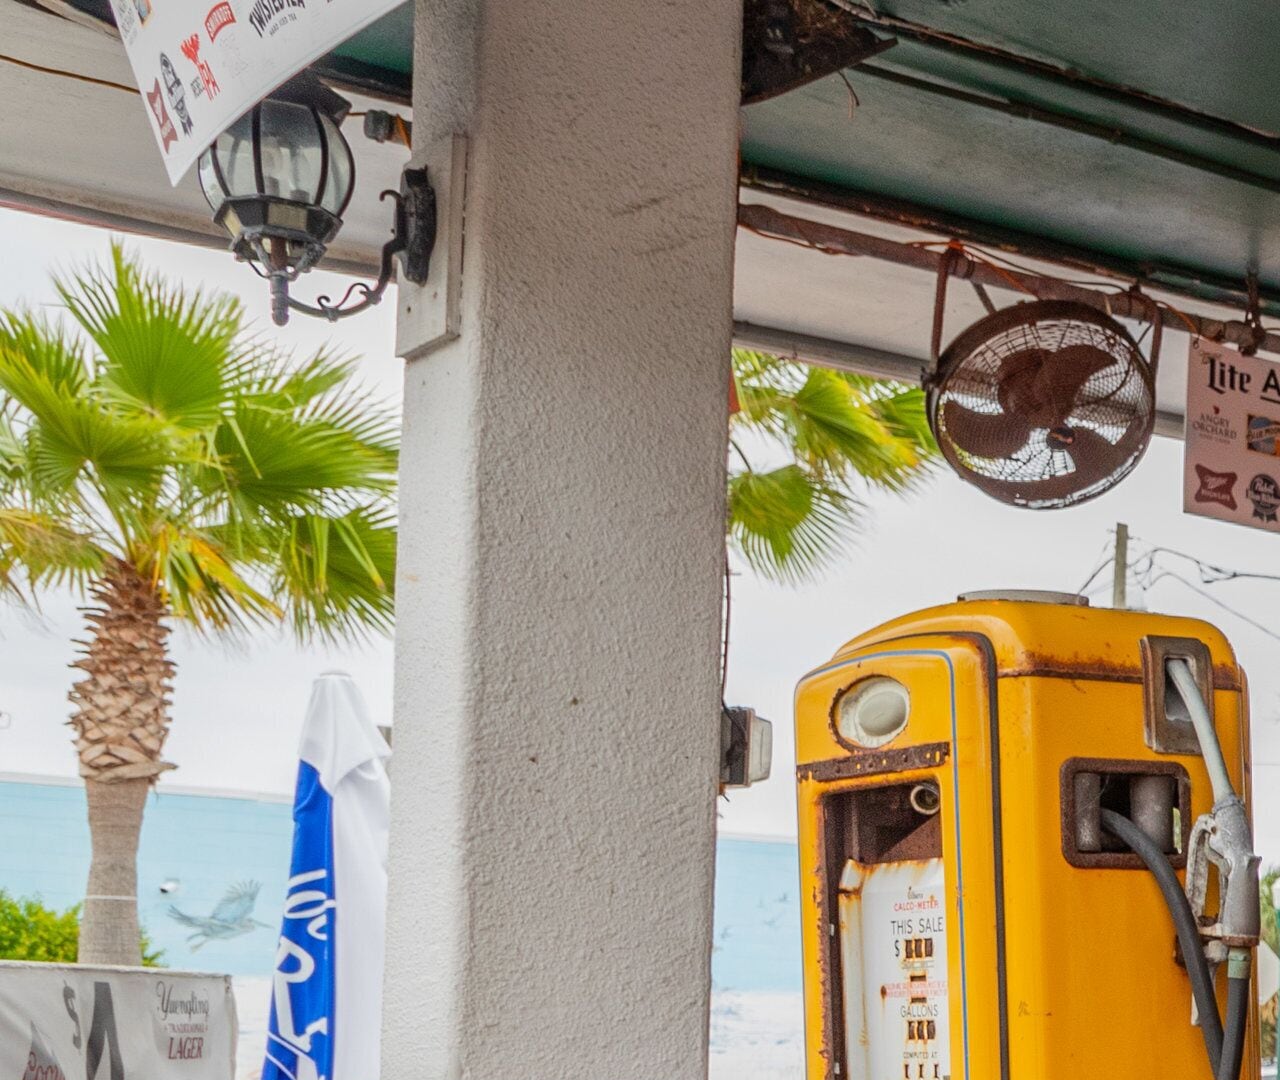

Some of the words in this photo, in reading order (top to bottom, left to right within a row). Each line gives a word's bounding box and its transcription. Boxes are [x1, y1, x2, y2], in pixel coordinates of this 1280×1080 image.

[1207, 357, 1251, 395] Lite
[1200, 414, 1230, 428] ANGRY
[1193, 422, 1237, 440] ORCHARD
[891, 919, 913, 935] THIS
[919, 917, 943, 934] SALE
[900, 1004, 938, 1018] GALLONS
[168, 1036, 204, 1060] LAGER
